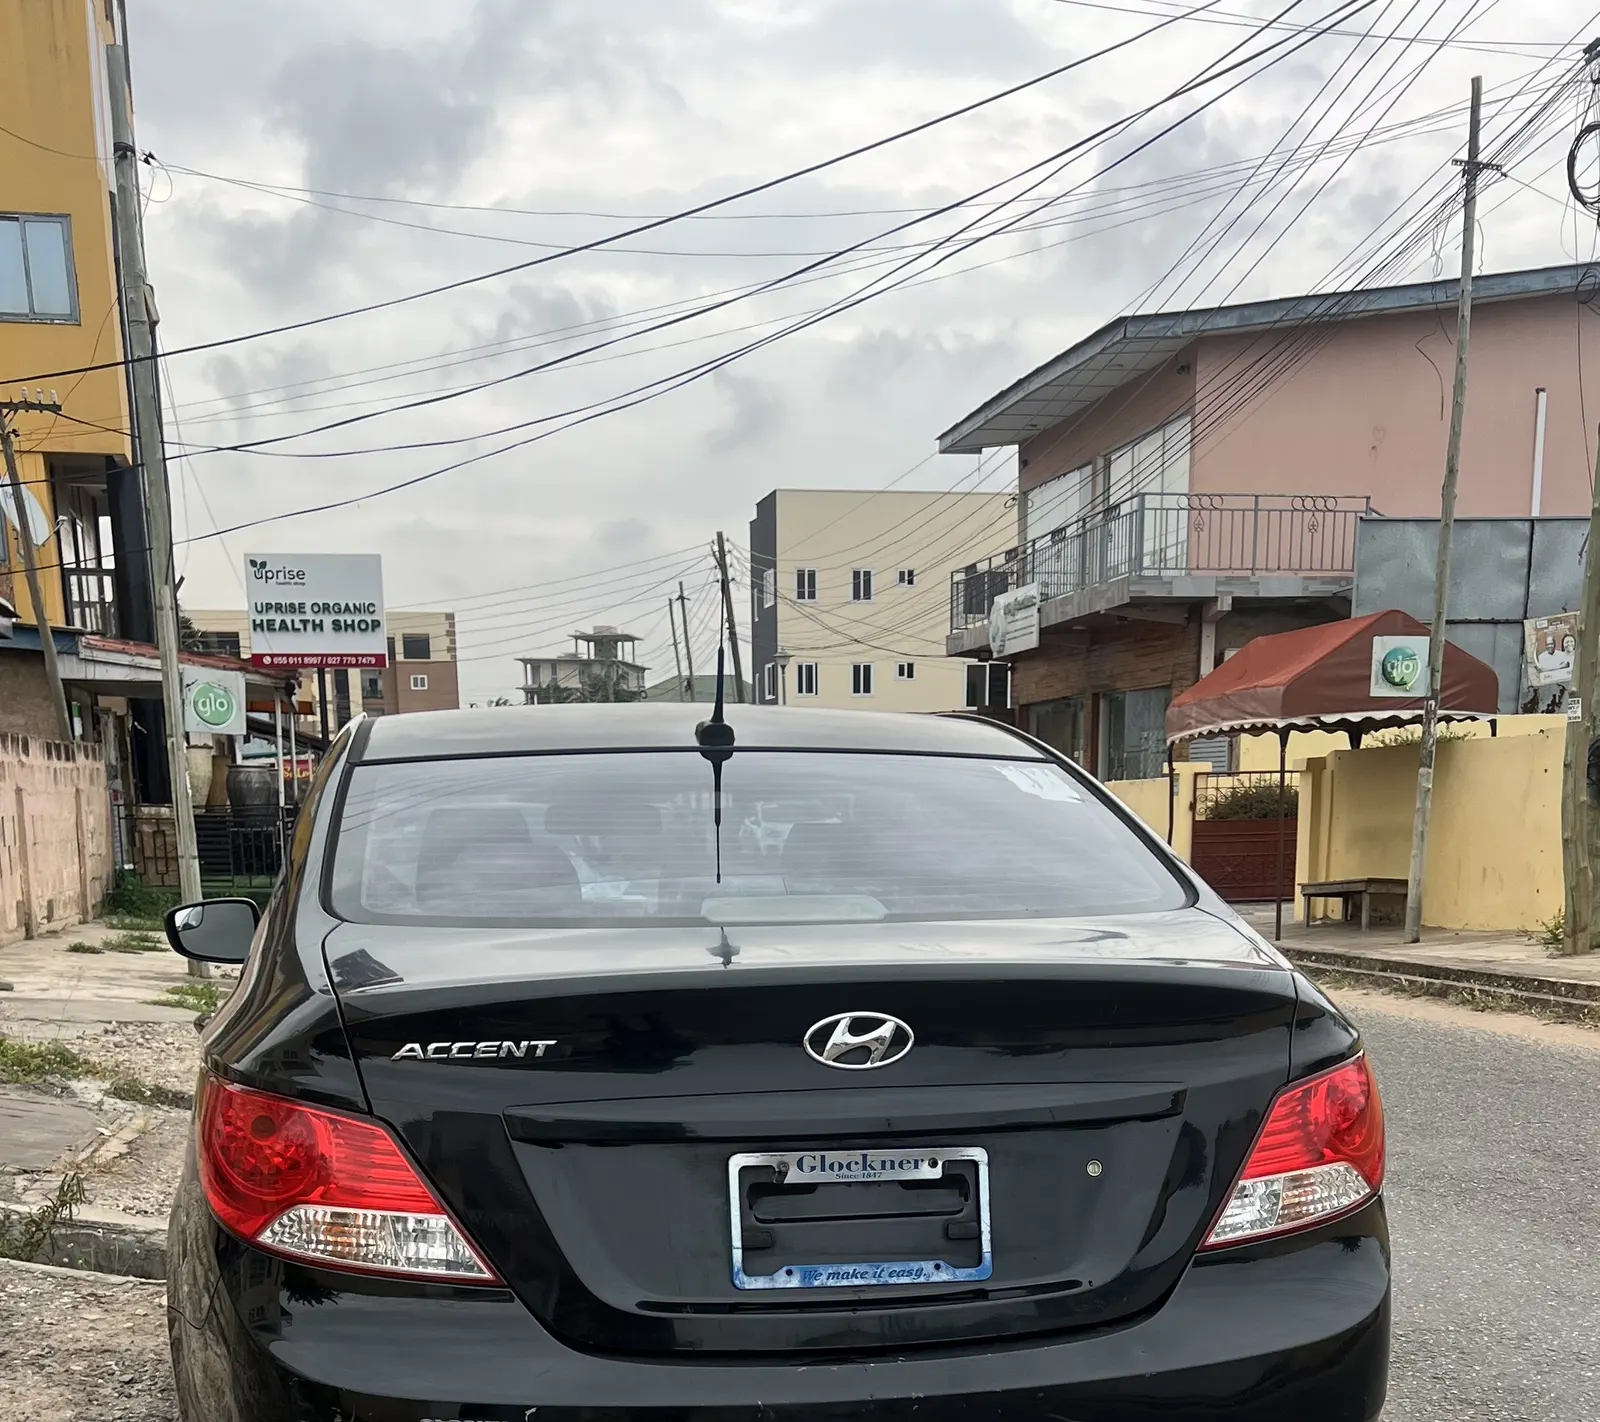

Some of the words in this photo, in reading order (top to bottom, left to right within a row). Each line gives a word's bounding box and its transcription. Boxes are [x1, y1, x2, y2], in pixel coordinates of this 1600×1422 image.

[254, 566, 306, 584] uprise
[254, 602, 307, 615] UPRISE
[310, 602, 376, 615] ORGANIC
[252, 619, 324, 633] HEALTH
[331, 619, 381, 633] SHOP
[1387, 655, 1413, 678] glo
[198, 692, 228, 717] glo
[391, 1040, 558, 1061] ACCENT
[796, 1153, 925, 1174] Glockner
[861, 1171, 883, 1179] 1847
[802, 1270, 823, 1281] We
[826, 1268, 869, 1281] make
[873, 1266, 884, 1279] it
